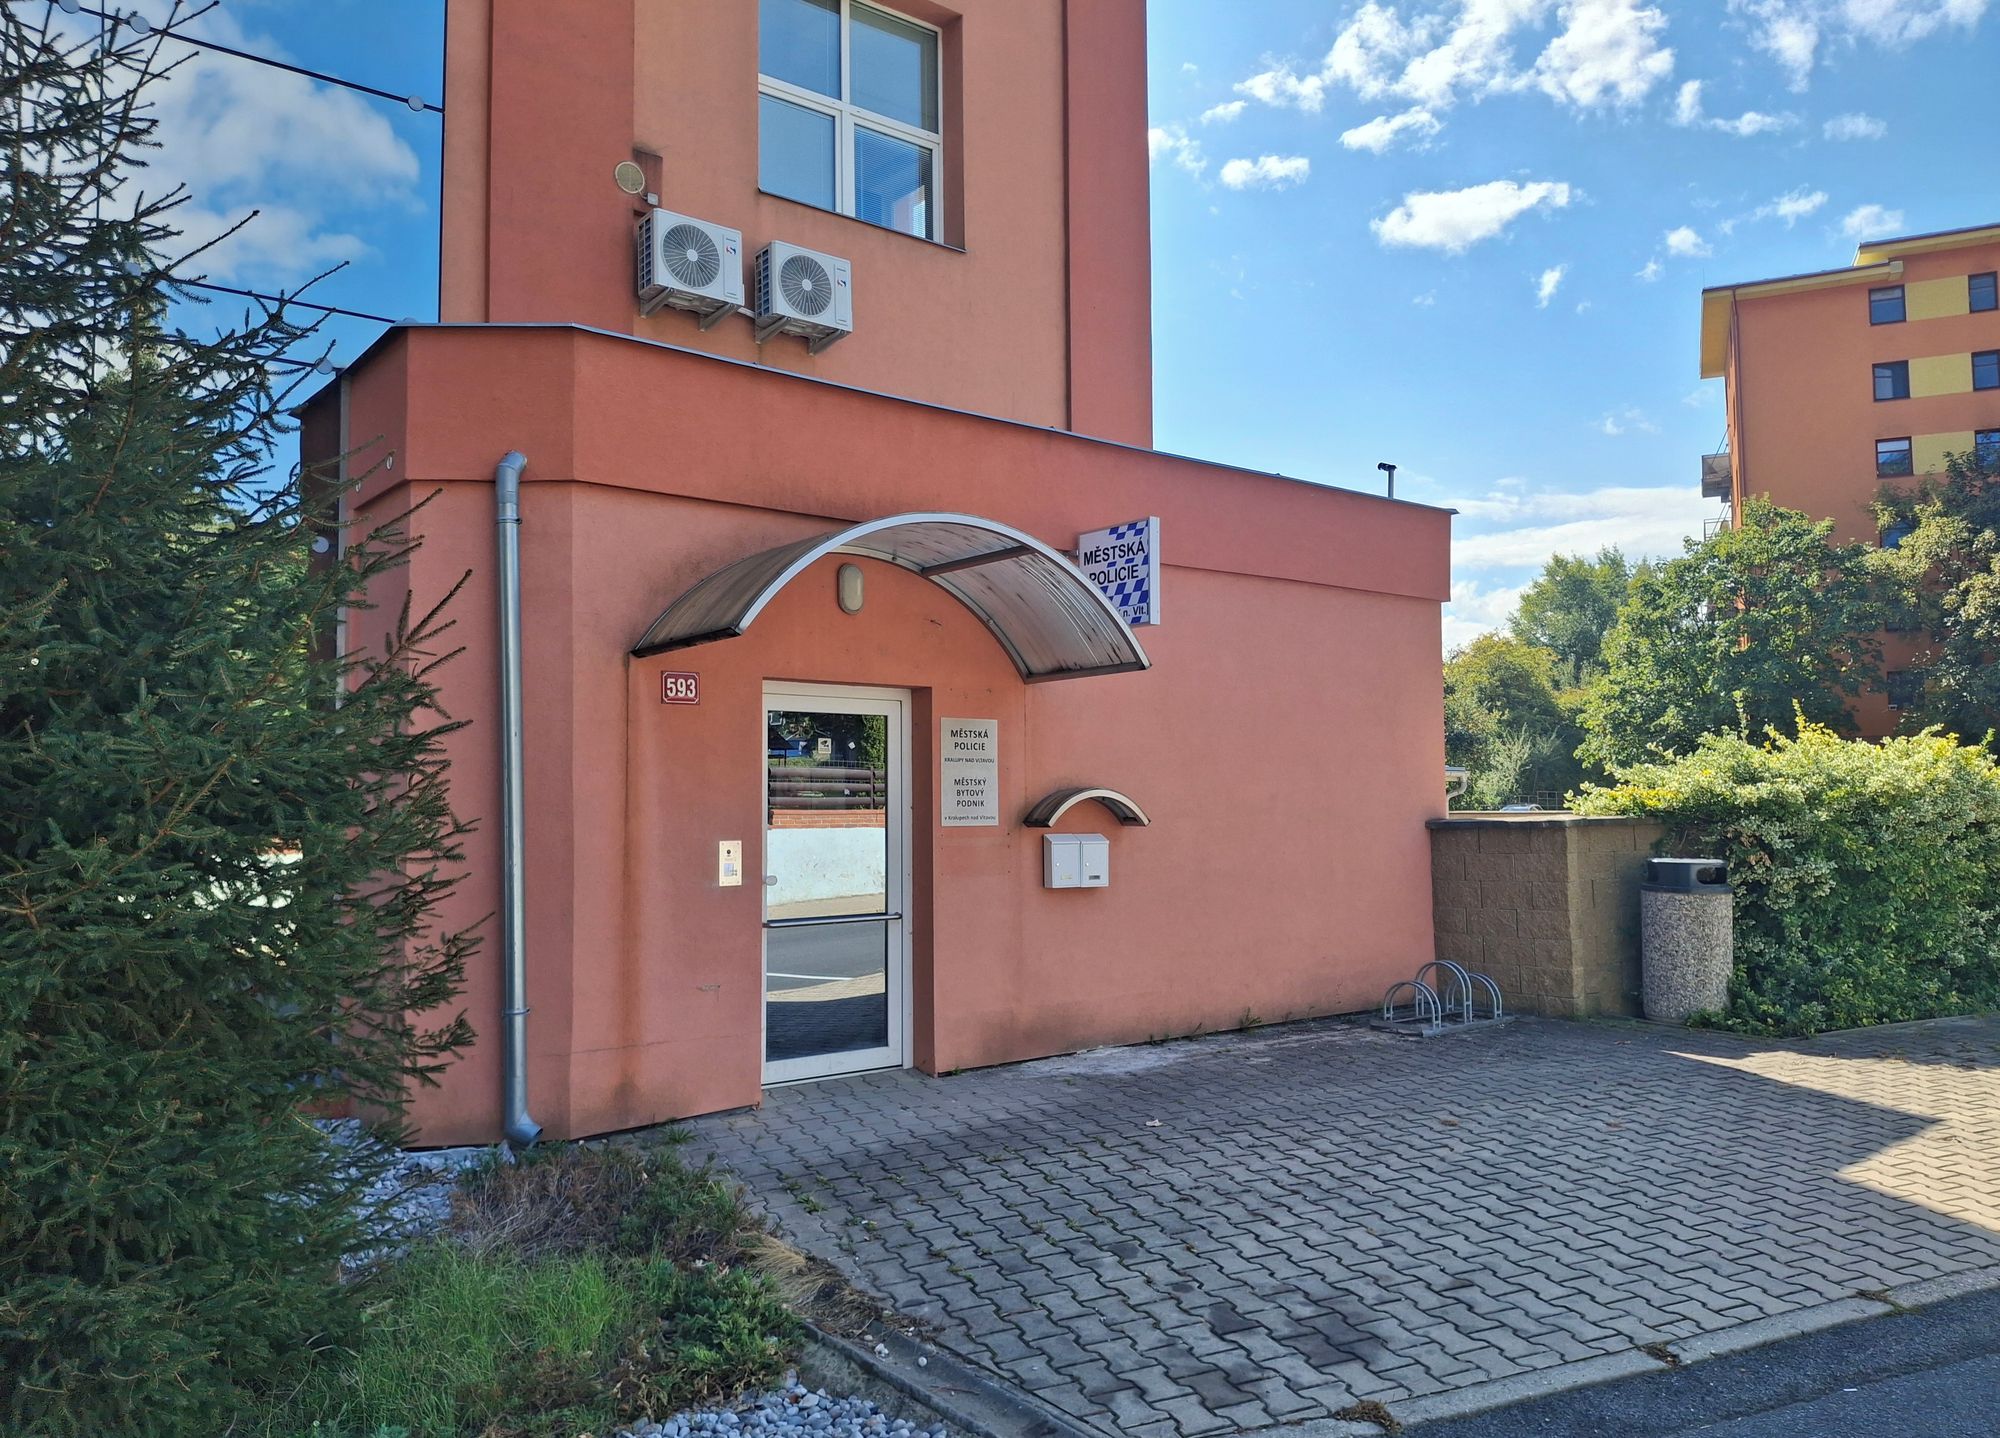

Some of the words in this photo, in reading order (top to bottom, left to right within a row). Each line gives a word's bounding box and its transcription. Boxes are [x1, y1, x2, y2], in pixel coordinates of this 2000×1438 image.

[1083, 536, 1146, 566] MĚSTSKÁ
[1089, 564, 1139, 585] POLICIE
[666, 678, 696, 697] 593
[950, 728, 989, 739] MĚSTSKÁ
[954, 742, 986, 751] POLICIE
[954, 777, 987, 786] MĚSTSKÝ
[956, 788, 985, 797] BYTOVÝ
[956, 800, 985, 808] PODNIK
